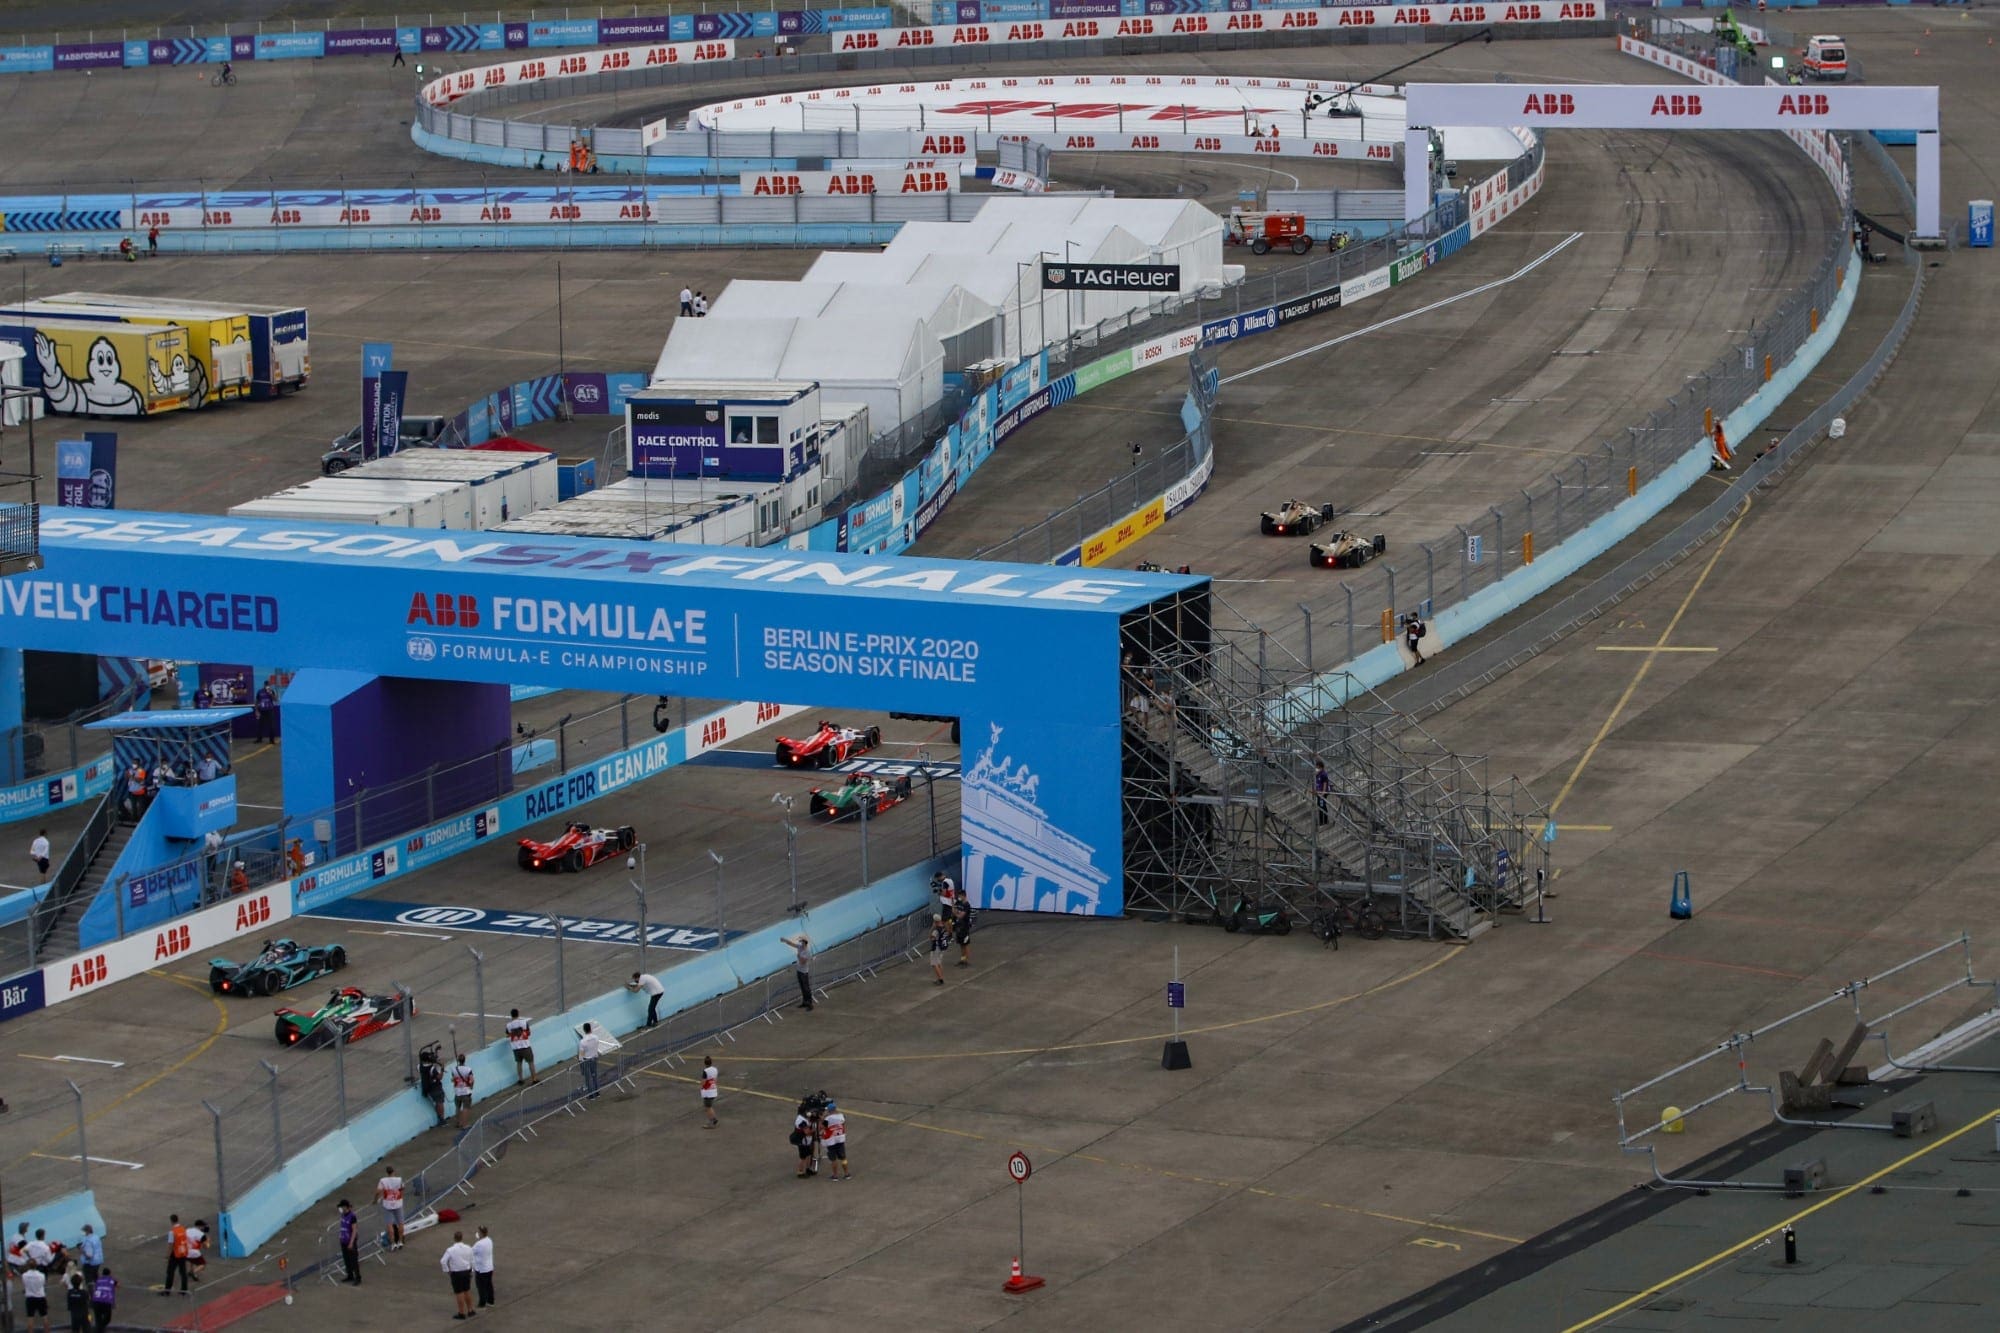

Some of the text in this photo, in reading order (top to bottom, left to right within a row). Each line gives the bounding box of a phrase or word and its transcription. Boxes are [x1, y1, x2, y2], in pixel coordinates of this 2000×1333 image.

[1339, 9, 1375, 25] ABB
[1393, 7, 1430, 23] ABB
[1450, 6, 1486, 22] ABB
[1505, 4, 1540, 20] ABB
[1560, 2, 1595, 18] ABB
[1117, 18, 1153, 35] ABB
[1172, 16, 1208, 32] ABB
[1227, 13, 1263, 29] ABB
[1281, 11, 1318, 27] ABB
[602, 24, 664, 34] #ABBFORMULAE
[953, 26, 989, 43] ABB
[1008, 23, 1043, 40] ABB
[1063, 21, 1098, 37] ABB
[329, 37, 391, 47] #ABBFORMULAE
[842, 33, 878, 50] ABB
[898, 29, 934, 46] ABB
[646, 48, 677, 65] ABB
[694, 43, 726, 60] ABB
[559, 57, 586, 74] ABB
[601, 52, 630, 69] ABB
[484, 68, 505, 86] ABB
[519, 62, 545, 80] ABB
[899, 85, 915, 93] ABB
[934, 83, 950, 91] ABB
[970, 81, 986, 89] ABB
[1001, 79, 1017, 87] ABB
[1074, 77, 1090, 85] ABB
[1110, 77, 1126, 85] ABB
[1145, 77, 1161, 85] ABB
[1215, 78, 1229, 86] ABB
[1522, 94, 1575, 115] ABB
[1650, 95, 1703, 115] ABB
[1778, 95, 1829, 115] ABB
[921, 135, 966, 154] ABB
[1066, 136, 1095, 148] ABB
[1131, 136, 1159, 148] ABB
[1194, 138, 1221, 150] ABB
[1254, 140, 1280, 152] ABB
[1313, 142, 1338, 155] ABB
[1366, 145, 1391, 158] ABB
[754, 176, 800, 195] ABB
[827, 175, 874, 194] ABB
[901, 172, 947, 193] ABB
[140, 212, 170, 225] ABB
[202, 211, 232, 224] ABB
[270, 210, 301, 223] ABB
[340, 209, 370, 222] ABB
[410, 207, 441, 220] ABB
[480, 206, 511, 219] ABB
[549, 205, 580, 219] ABB
[620, 205, 651, 218] ABB
[1244, 315, 1266, 331] Allianz
[1206, 326, 1228, 340] Allianz
[1180, 335, 1197, 348] BOSCH
[1145, 345, 1162, 360] BOSCH
[370, 356, 386, 367] TV
[383, 403, 391, 434] ACTION
[637, 411, 660, 420] modis
[637, 435, 719, 448] RACE CONTROL
[91, 473, 109, 508] FIA
[32, 519, 1146, 604] SEASON SIX FINALE
[406, 592, 706, 645] ABB FORMULA-E
[764, 627, 979, 660] BERLIN E-PRIX 2020
[409, 643, 707, 676] FIA FORMULA-E CHAMPIONSHIP
[764, 650, 976, 683] SEASON SIX FINALE
[757, 703, 780, 724] ABB
[702, 717, 726, 748] ABB
[526, 742, 667, 820] RACE FOR CLEAN AIR
[407, 837, 423, 854] ABB
[425, 819, 472, 848] FORMULA-E
[149, 861, 198, 894] BERLIN
[299, 877, 316, 894] ABB
[318, 856, 368, 887] FORMULA-E
[236, 896, 270, 931] ABB
[490, 914, 719, 944] Allianz
[155, 925, 191, 960] ABB
[69, 954, 107, 991] ABB
[2, 986, 28, 1009] Bär
[1013, 1160, 1023, 1174] 10
